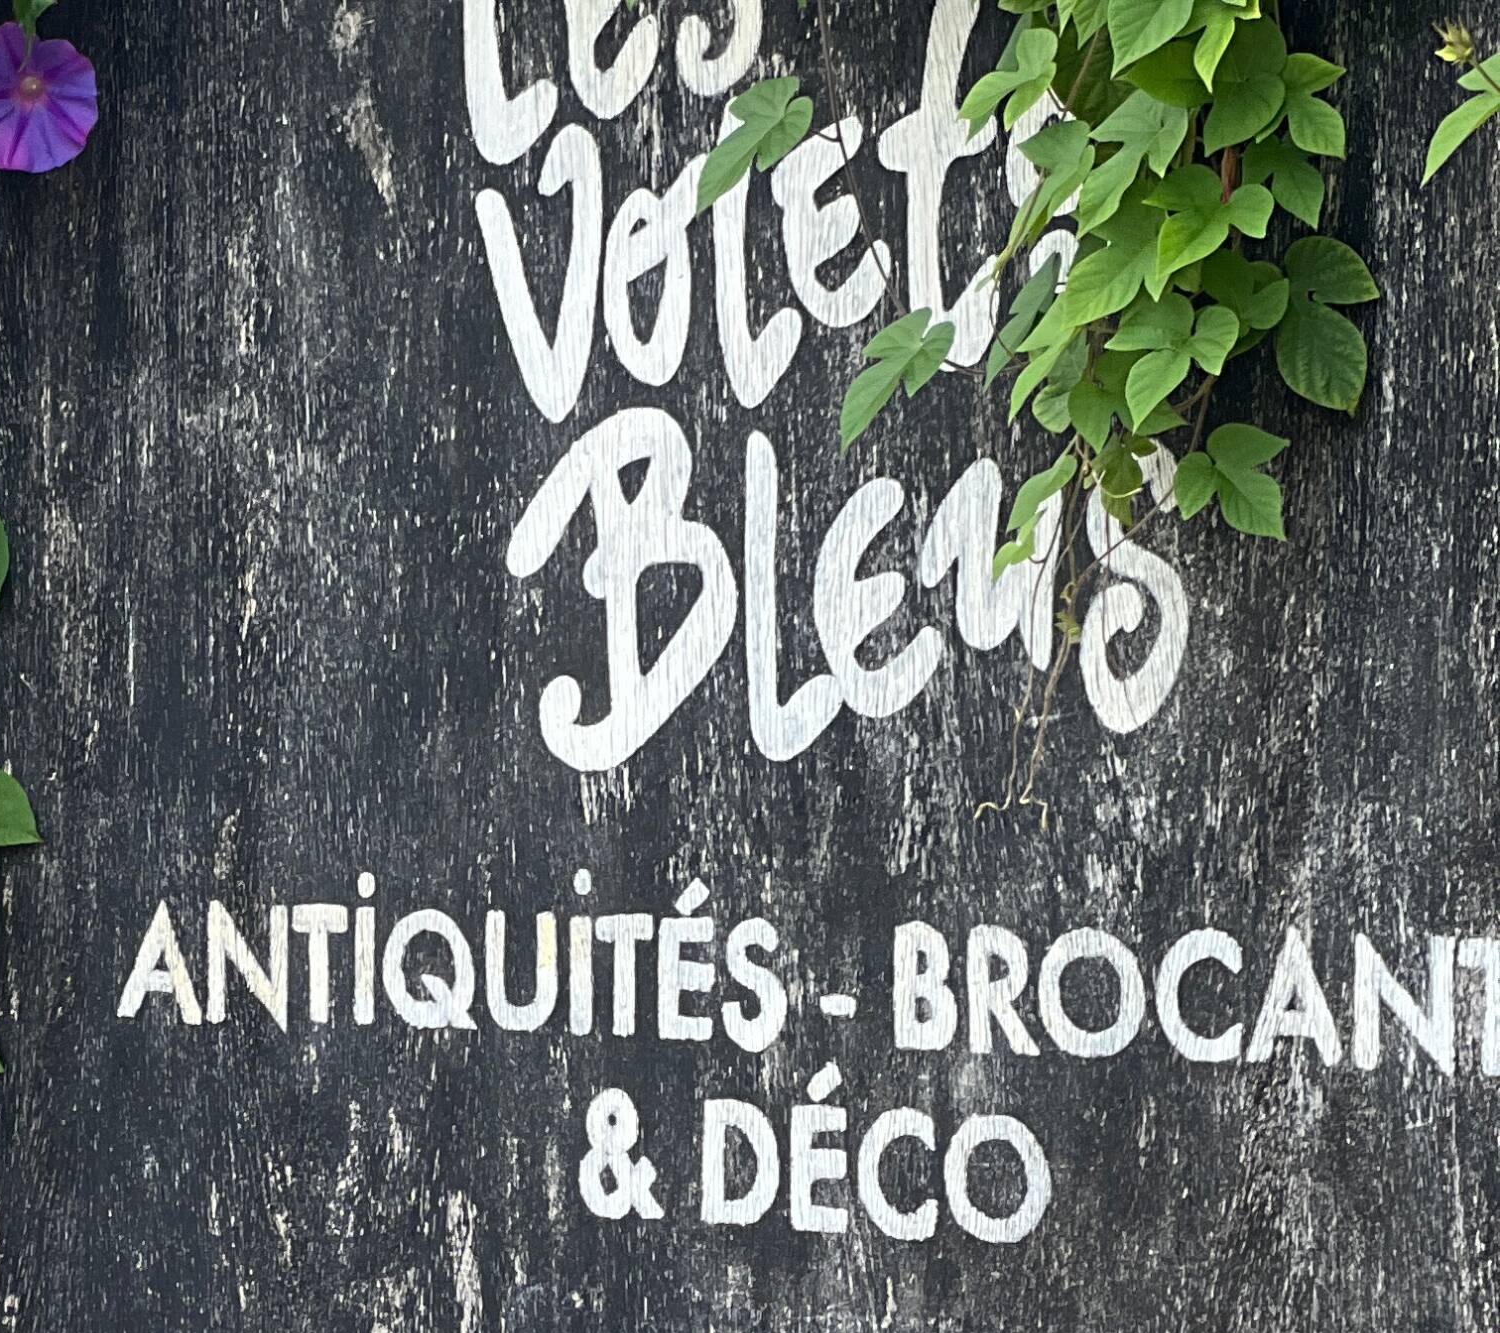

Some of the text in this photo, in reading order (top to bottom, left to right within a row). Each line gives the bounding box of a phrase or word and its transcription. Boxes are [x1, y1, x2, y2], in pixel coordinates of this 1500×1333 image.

[893, 919, 1500, 1078] BROCANT
[579, 1061, 1052, 1244] & DÉCO
